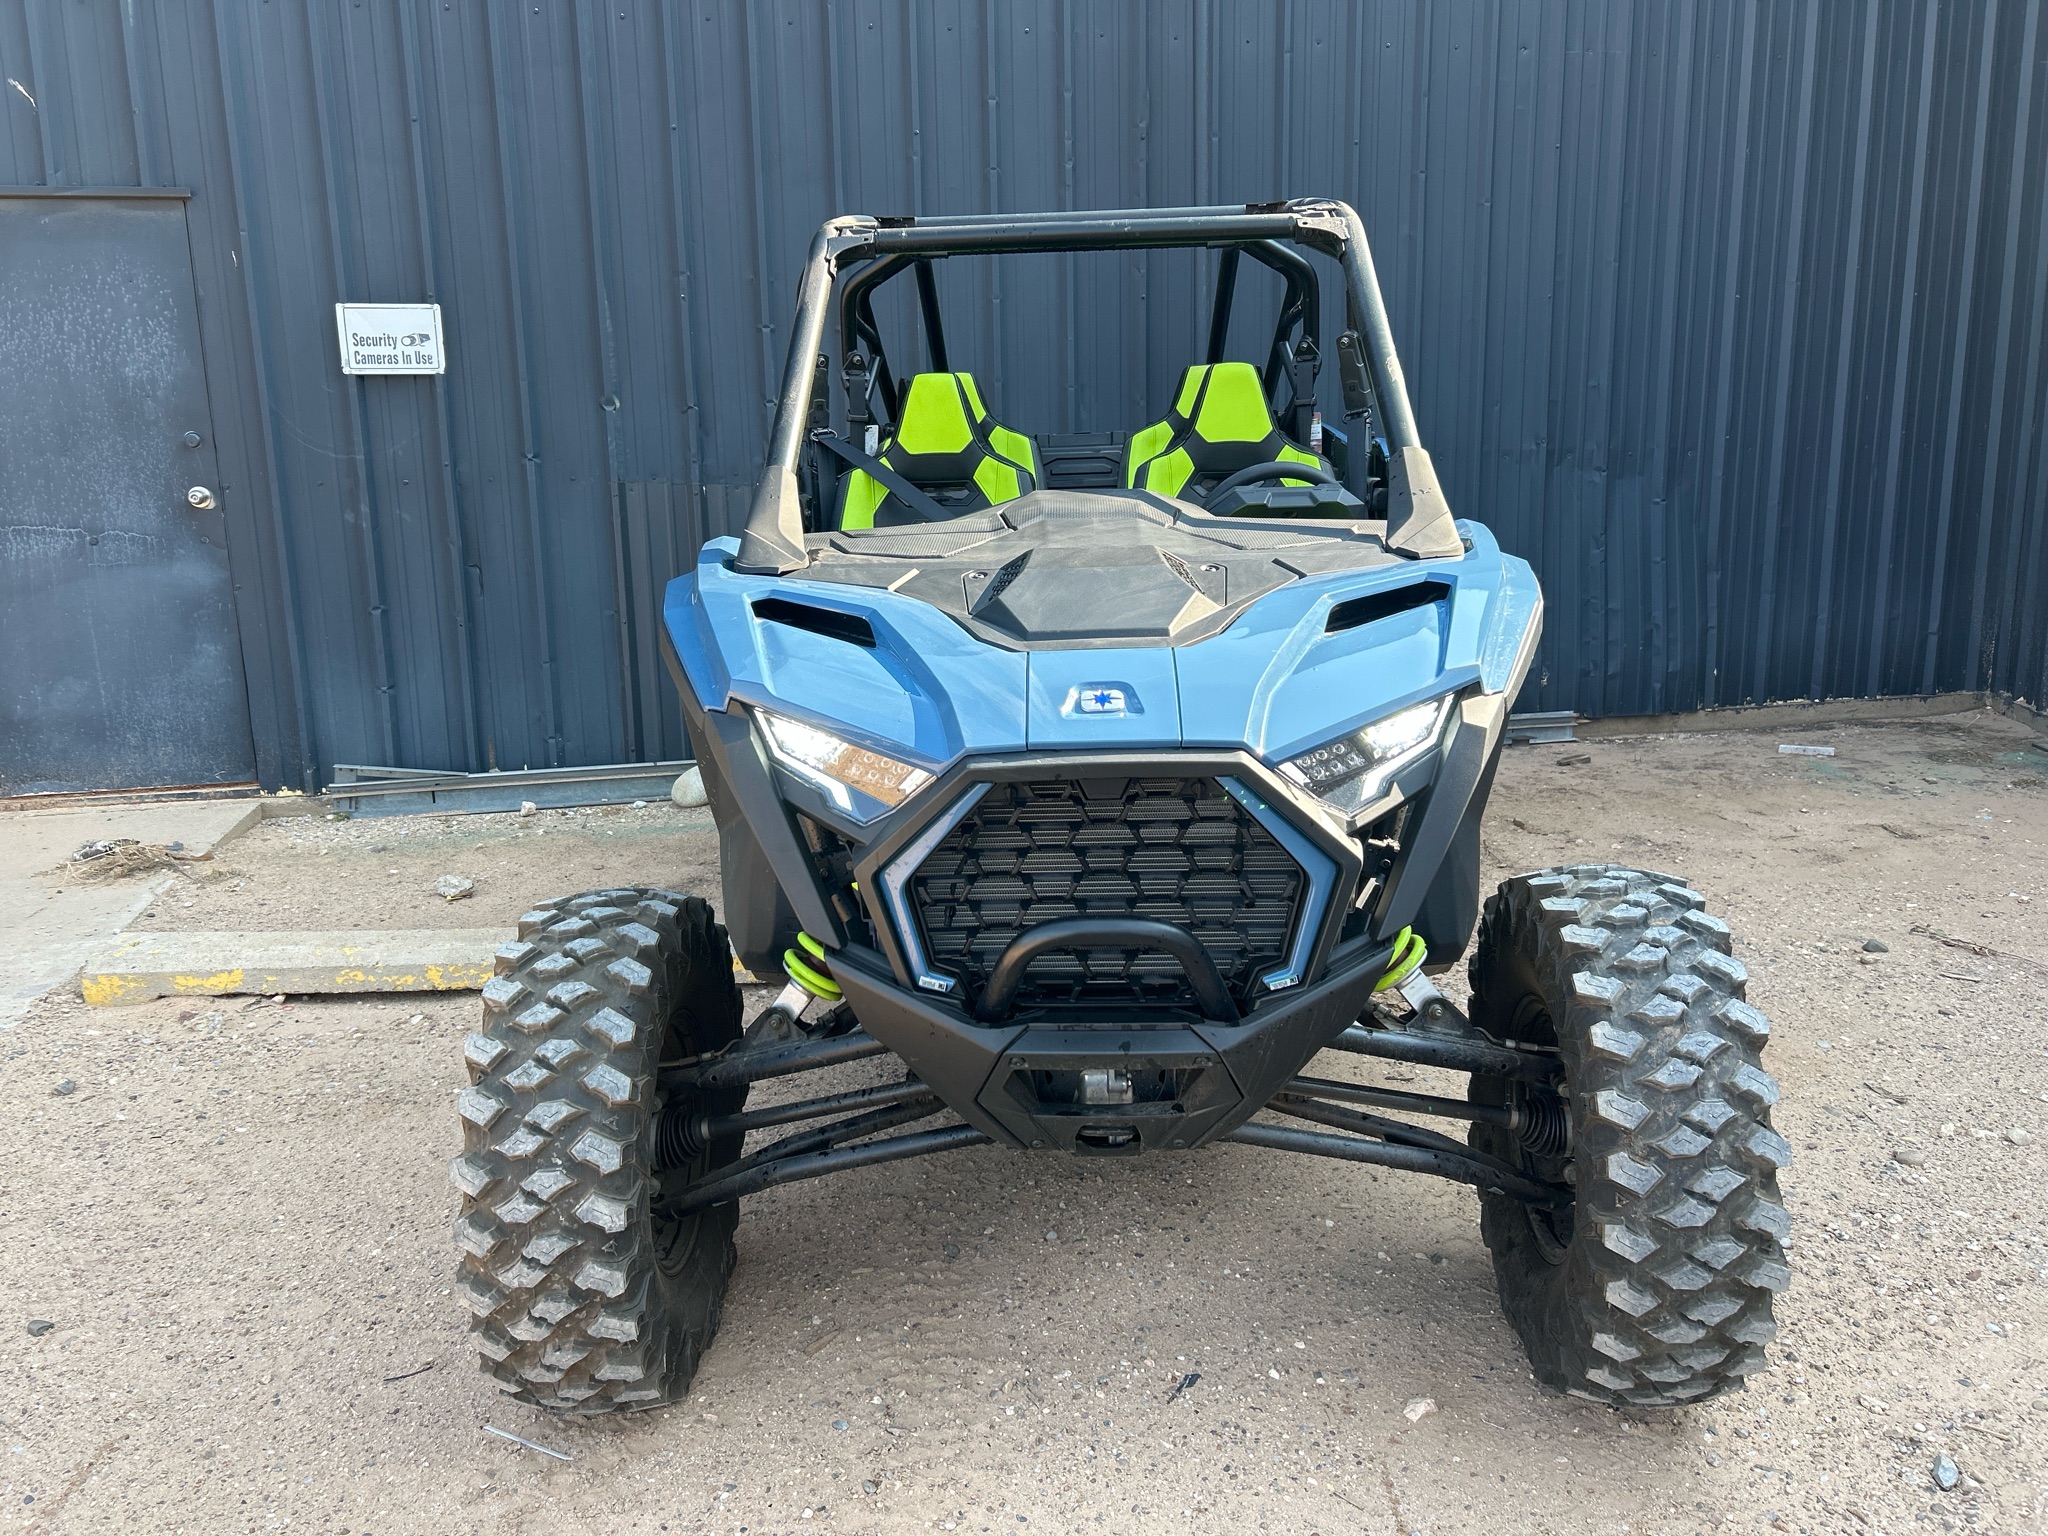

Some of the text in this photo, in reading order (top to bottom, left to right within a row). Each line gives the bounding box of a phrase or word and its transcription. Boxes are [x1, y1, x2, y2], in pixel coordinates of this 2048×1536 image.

[352, 332, 398, 350] Security
[354, 350, 399, 365] Cameras
[402, 350, 412, 365] In
[414, 350, 434, 365] Use
